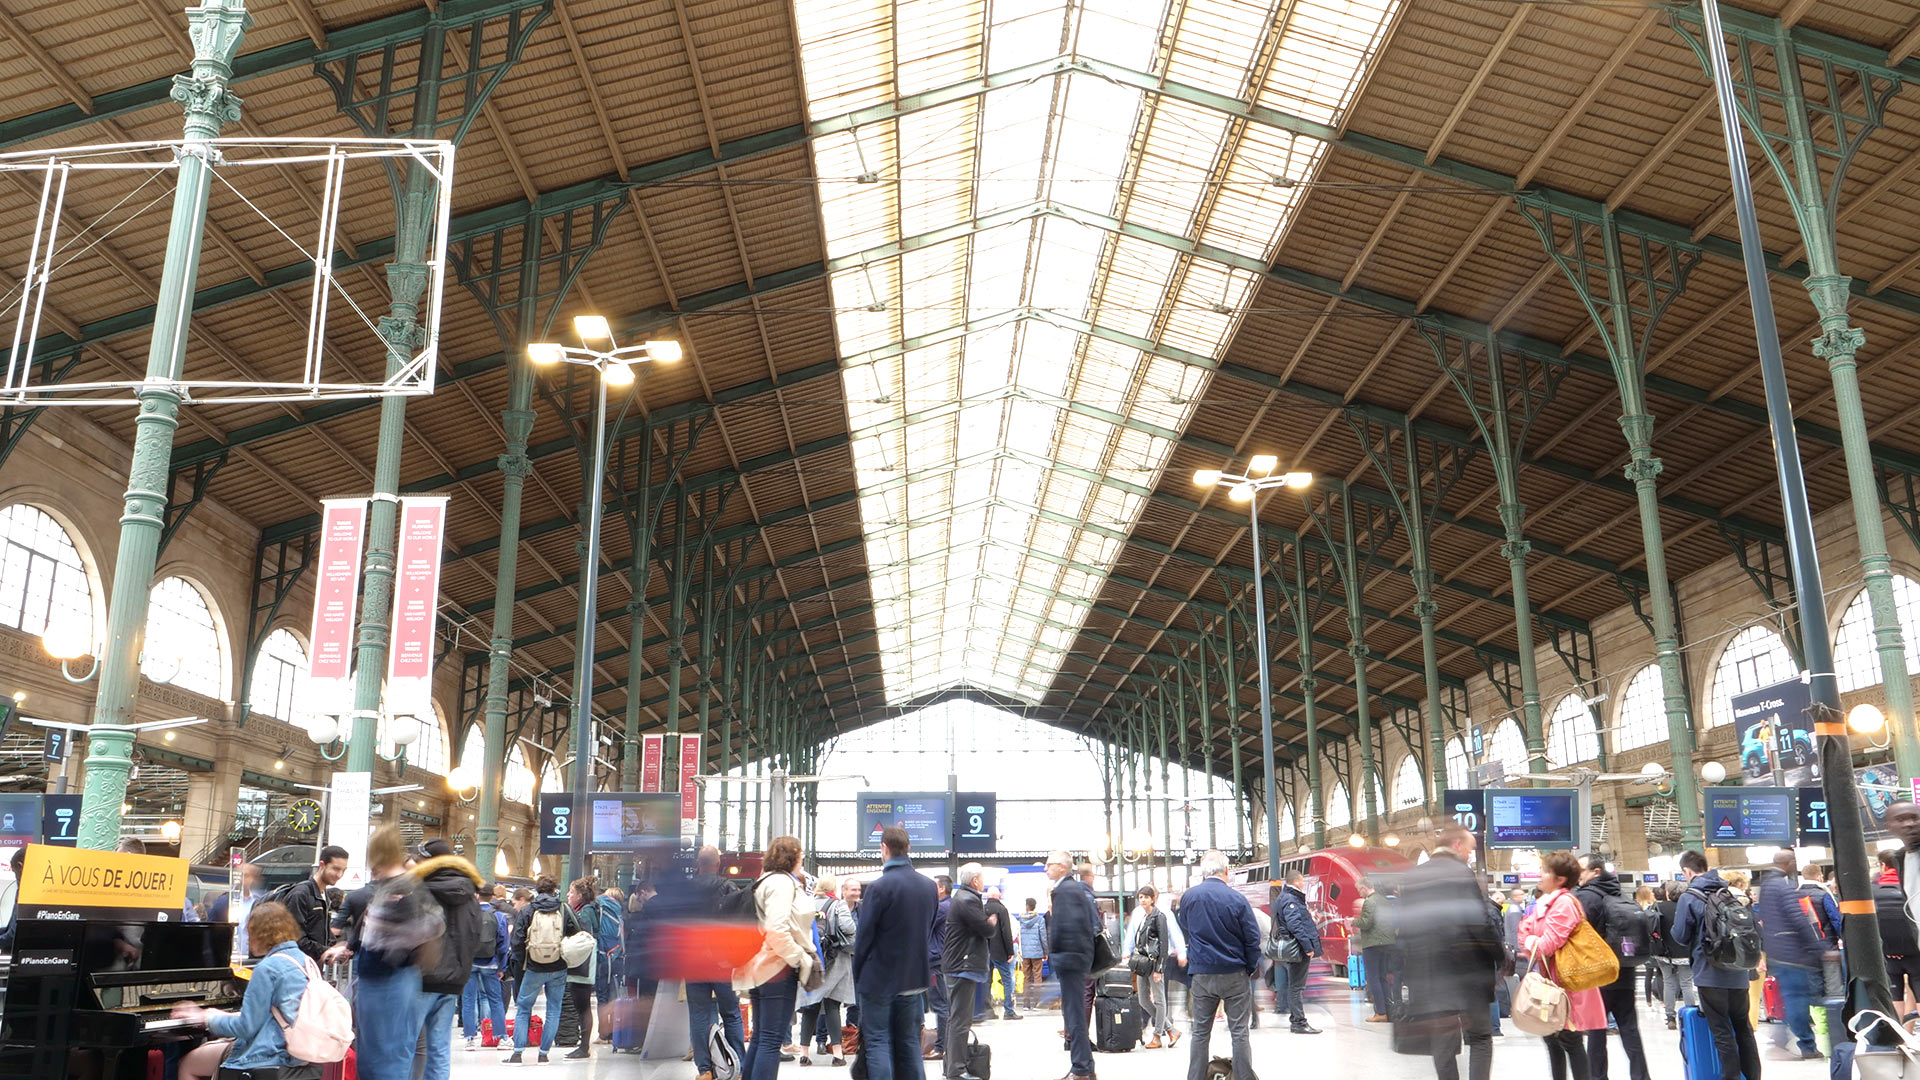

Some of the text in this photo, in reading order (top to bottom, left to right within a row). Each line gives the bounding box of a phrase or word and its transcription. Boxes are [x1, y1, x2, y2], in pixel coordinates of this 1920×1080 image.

[52, 741, 59, 755] 7
[1780, 735, 1792, 750] 11
[58, 818, 71, 836] 7
[554, 816, 568, 835] 8
[969, 815, 983, 834] 9
[1453, 813, 1477, 831] 10
[1807, 810, 1830, 828] 11
[42, 860, 174, 891] À VOUS DE JOUER !
[37, 910, 80, 920] #PianoEnGare
[21, 957, 69, 965] #PianoEnGare
